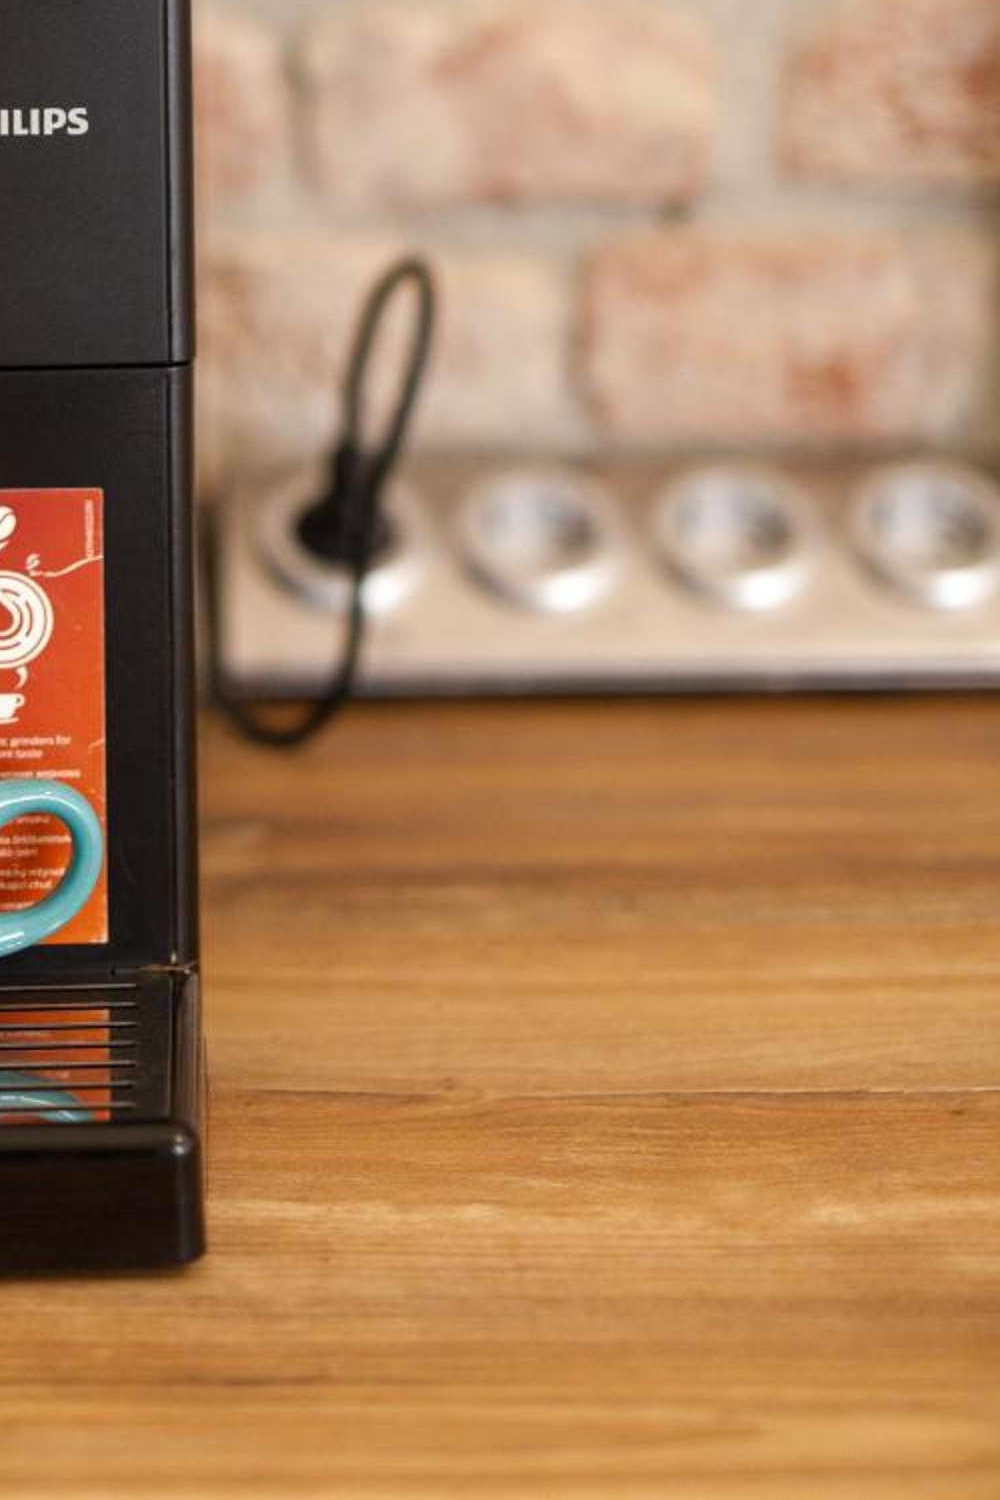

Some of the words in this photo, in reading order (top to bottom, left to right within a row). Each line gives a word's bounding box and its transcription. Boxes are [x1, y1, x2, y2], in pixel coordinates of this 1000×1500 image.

[9, 735, 55, 748] grinders
[56, 734, 71, 745] for
[15, 749, 43, 759] taste
